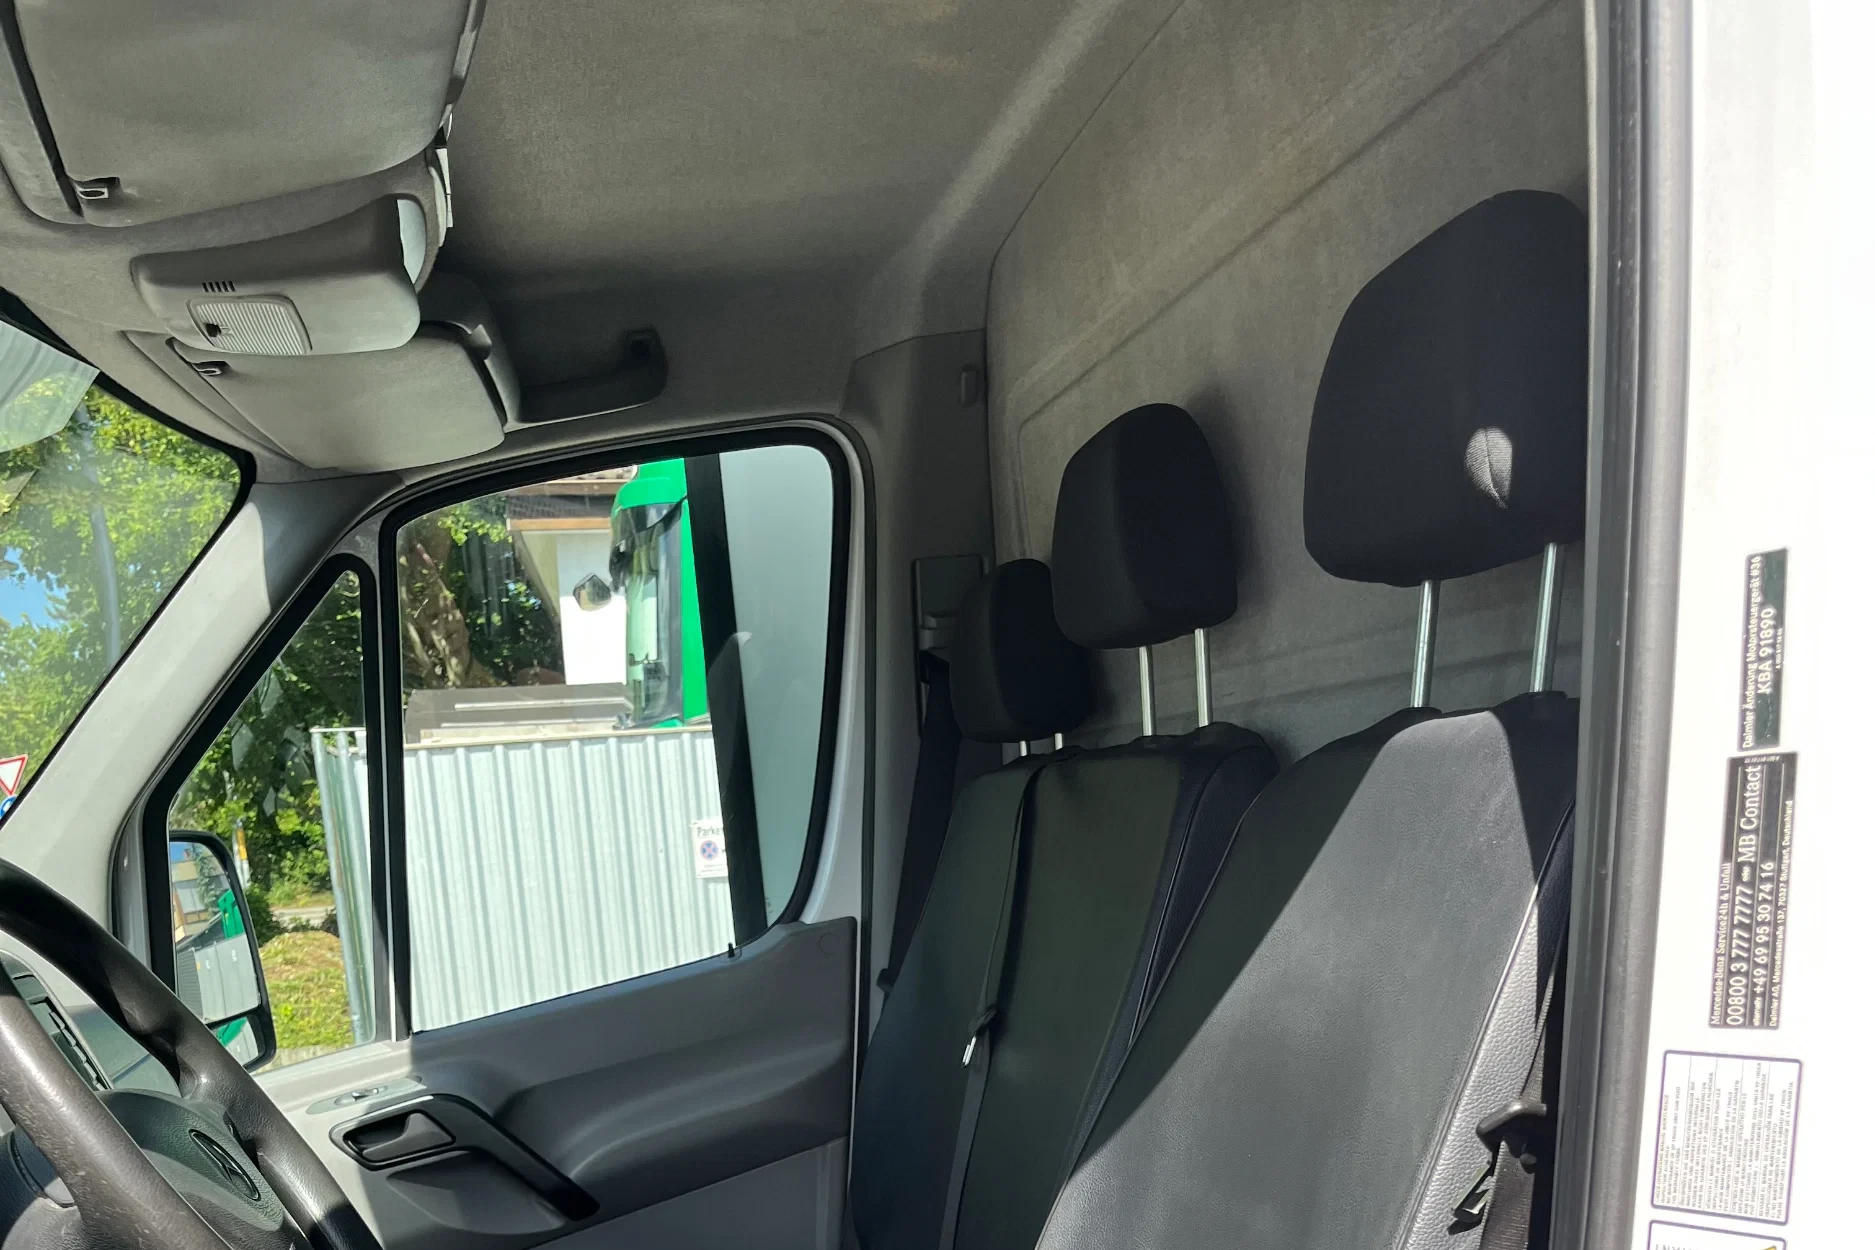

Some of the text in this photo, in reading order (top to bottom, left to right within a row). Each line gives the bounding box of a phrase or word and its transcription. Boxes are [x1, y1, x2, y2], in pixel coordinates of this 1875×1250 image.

[1742, 556, 1761, 747] Daimler Änderung Motorsteuergerät #36
[1757, 607, 1773, 694] KBA 91890
[1739, 764, 1761, 829] Contact
[1737, 834, 1756, 862] MB
[1760, 861, 1774, 877] 16
[1733, 885, 1753, 924] 7777
[1758, 883, 1772, 900] 74
[1757, 904, 1770, 921] 30
[1711, 956, 1724, 1024] Mercedes-Benz
[1720, 862, 1731, 890] Unfall
[1731, 929, 1750, 957] 777
[1755, 925, 1769, 942] 95
[1730, 962, 1748, 972] 3
[1754, 947, 1767, 963] 69
[1752, 968, 1766, 993] +49
[1726, 976, 1746, 1024] 00800
[1769, 999, 1778, 1026] Daimler
